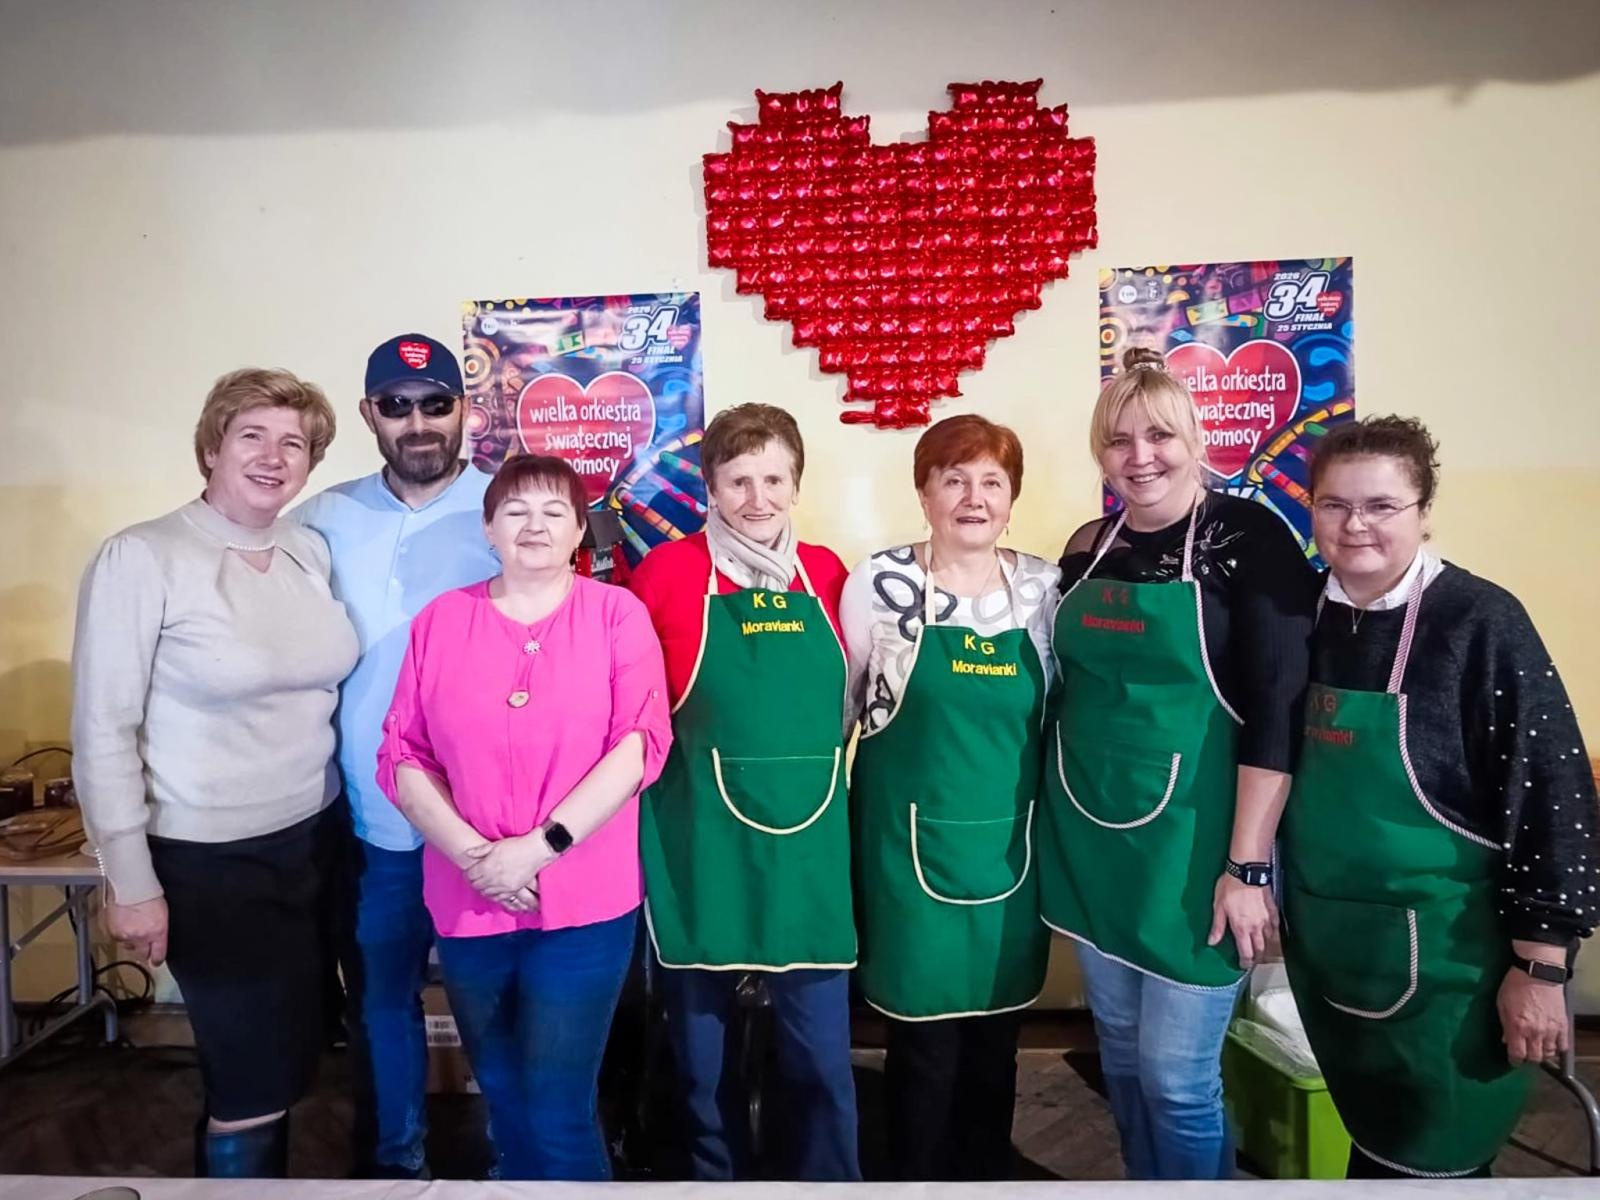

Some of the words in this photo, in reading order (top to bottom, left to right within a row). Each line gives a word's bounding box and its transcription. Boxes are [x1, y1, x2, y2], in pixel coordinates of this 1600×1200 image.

[1265, 272, 1330, 321] 34
[618, 305, 679, 353] 34
[1182, 366, 1218, 392] ielka
[1220, 366, 1287, 392] orkiestra
[529, 396, 578, 423] wielka
[580, 397, 642, 422] orkiestra
[1197, 396, 1276, 430] wiątecznej
[544, 425, 633, 459] świątecznej
[753, 592, 767, 609] K
[772, 595, 787, 609] G
[742, 620, 805, 635] Moravianki
[964, 634, 977, 651] K
[980, 642, 996, 655] G
[952, 659, 1018, 676] Moravianki
